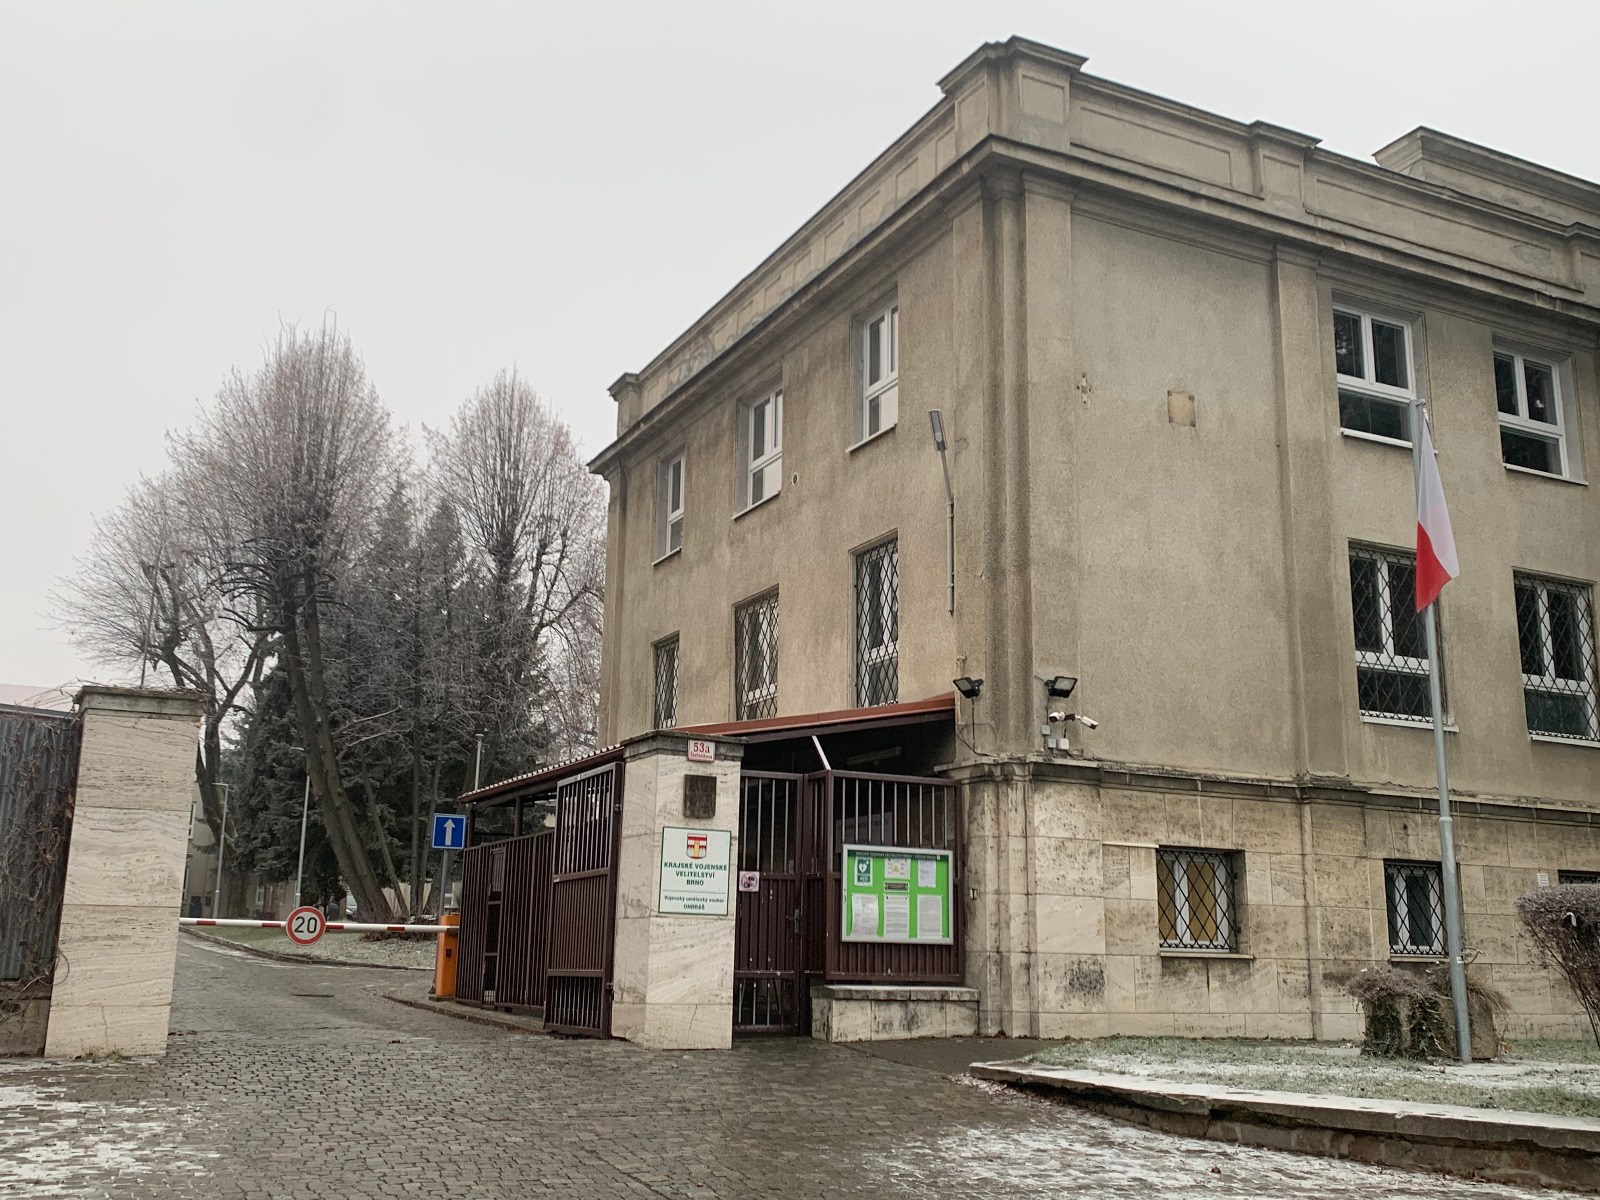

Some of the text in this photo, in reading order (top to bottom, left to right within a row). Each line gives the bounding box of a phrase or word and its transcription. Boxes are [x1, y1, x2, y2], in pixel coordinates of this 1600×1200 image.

[694, 742, 709, 753] 53a
[664, 861, 693, 869] KRAJSKÉ
[294, 916, 318, 933] 20
